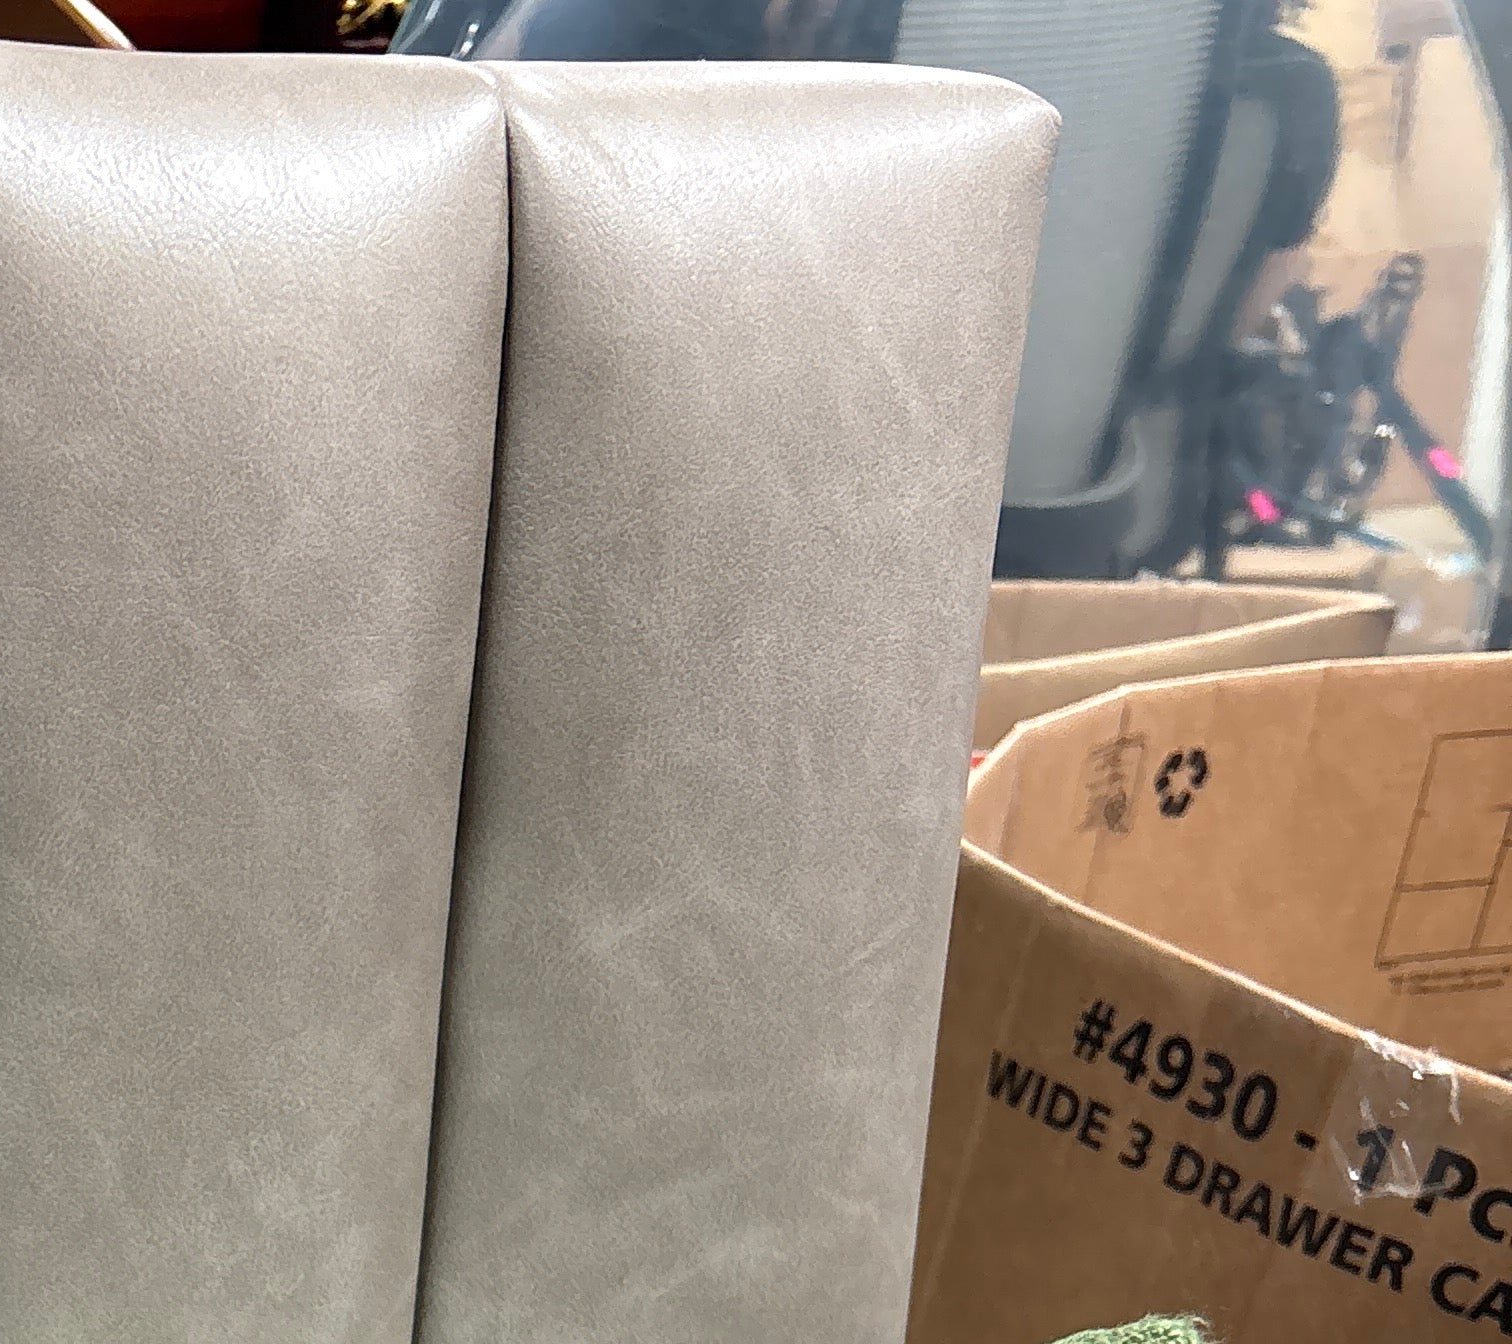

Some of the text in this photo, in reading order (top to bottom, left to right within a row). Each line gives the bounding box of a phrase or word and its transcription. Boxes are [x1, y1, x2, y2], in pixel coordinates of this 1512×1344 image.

[988, 1049, 1113, 1151] WIDE
[1118, 1119, 1154, 1170] 3
[1162, 1142, 1415, 1292] DRAWER
[1072, 999, 1512, 1246] #4930 - 1 PC
